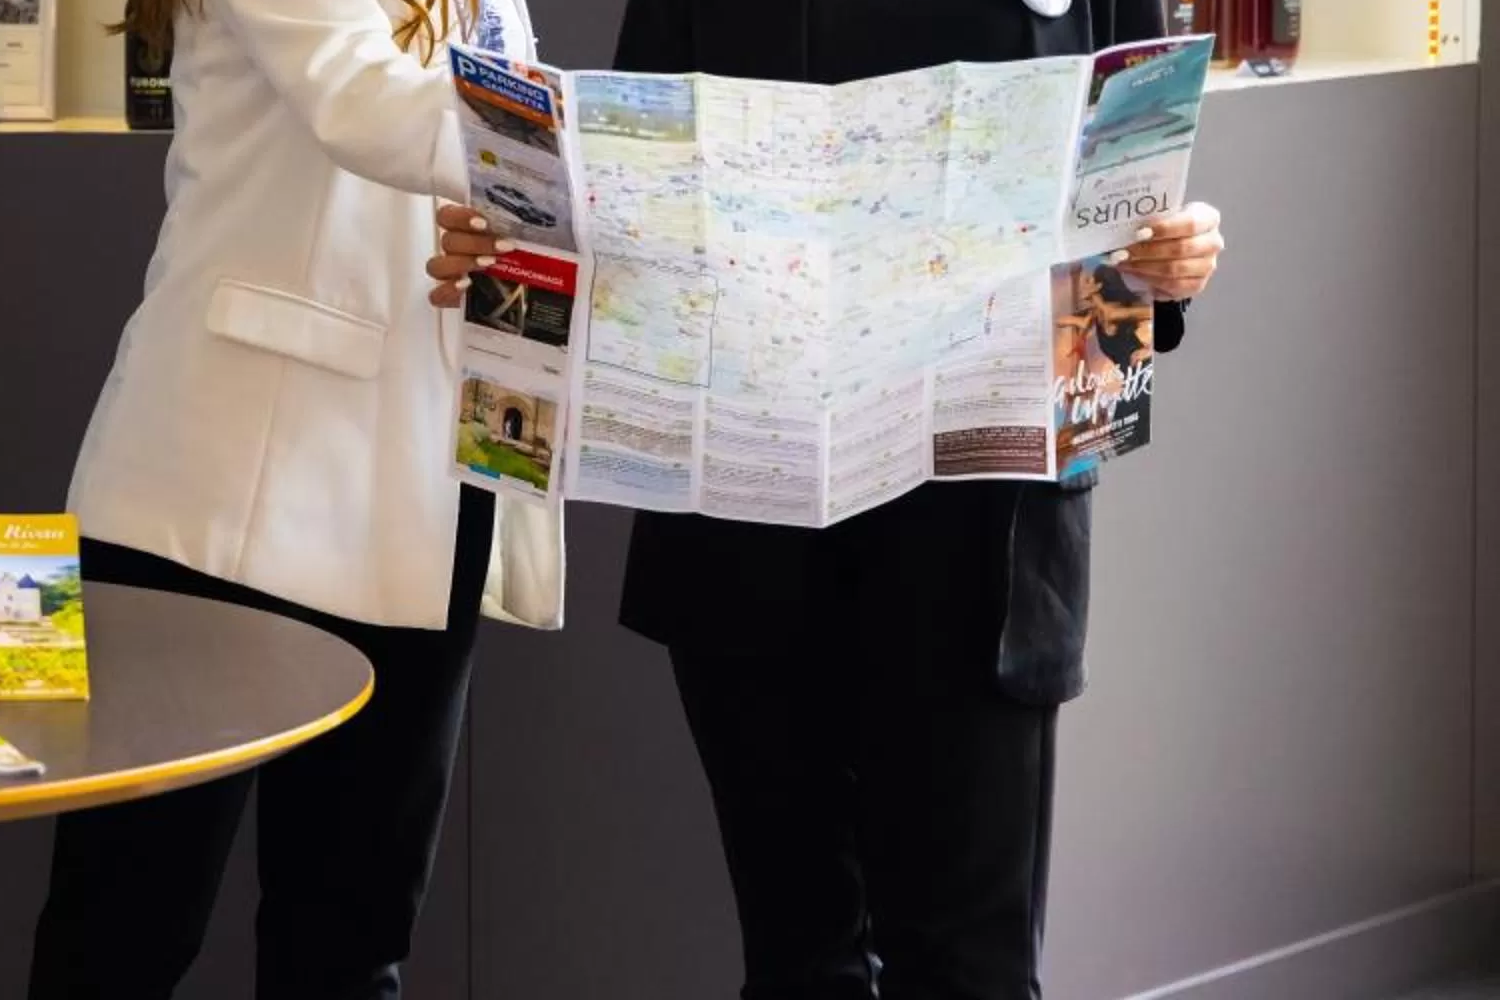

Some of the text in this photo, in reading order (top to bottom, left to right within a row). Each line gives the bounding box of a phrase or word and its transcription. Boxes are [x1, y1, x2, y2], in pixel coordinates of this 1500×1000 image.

[457, 55, 546, 101] P PARKING
[1077, 192, 1170, 229] TOURS
